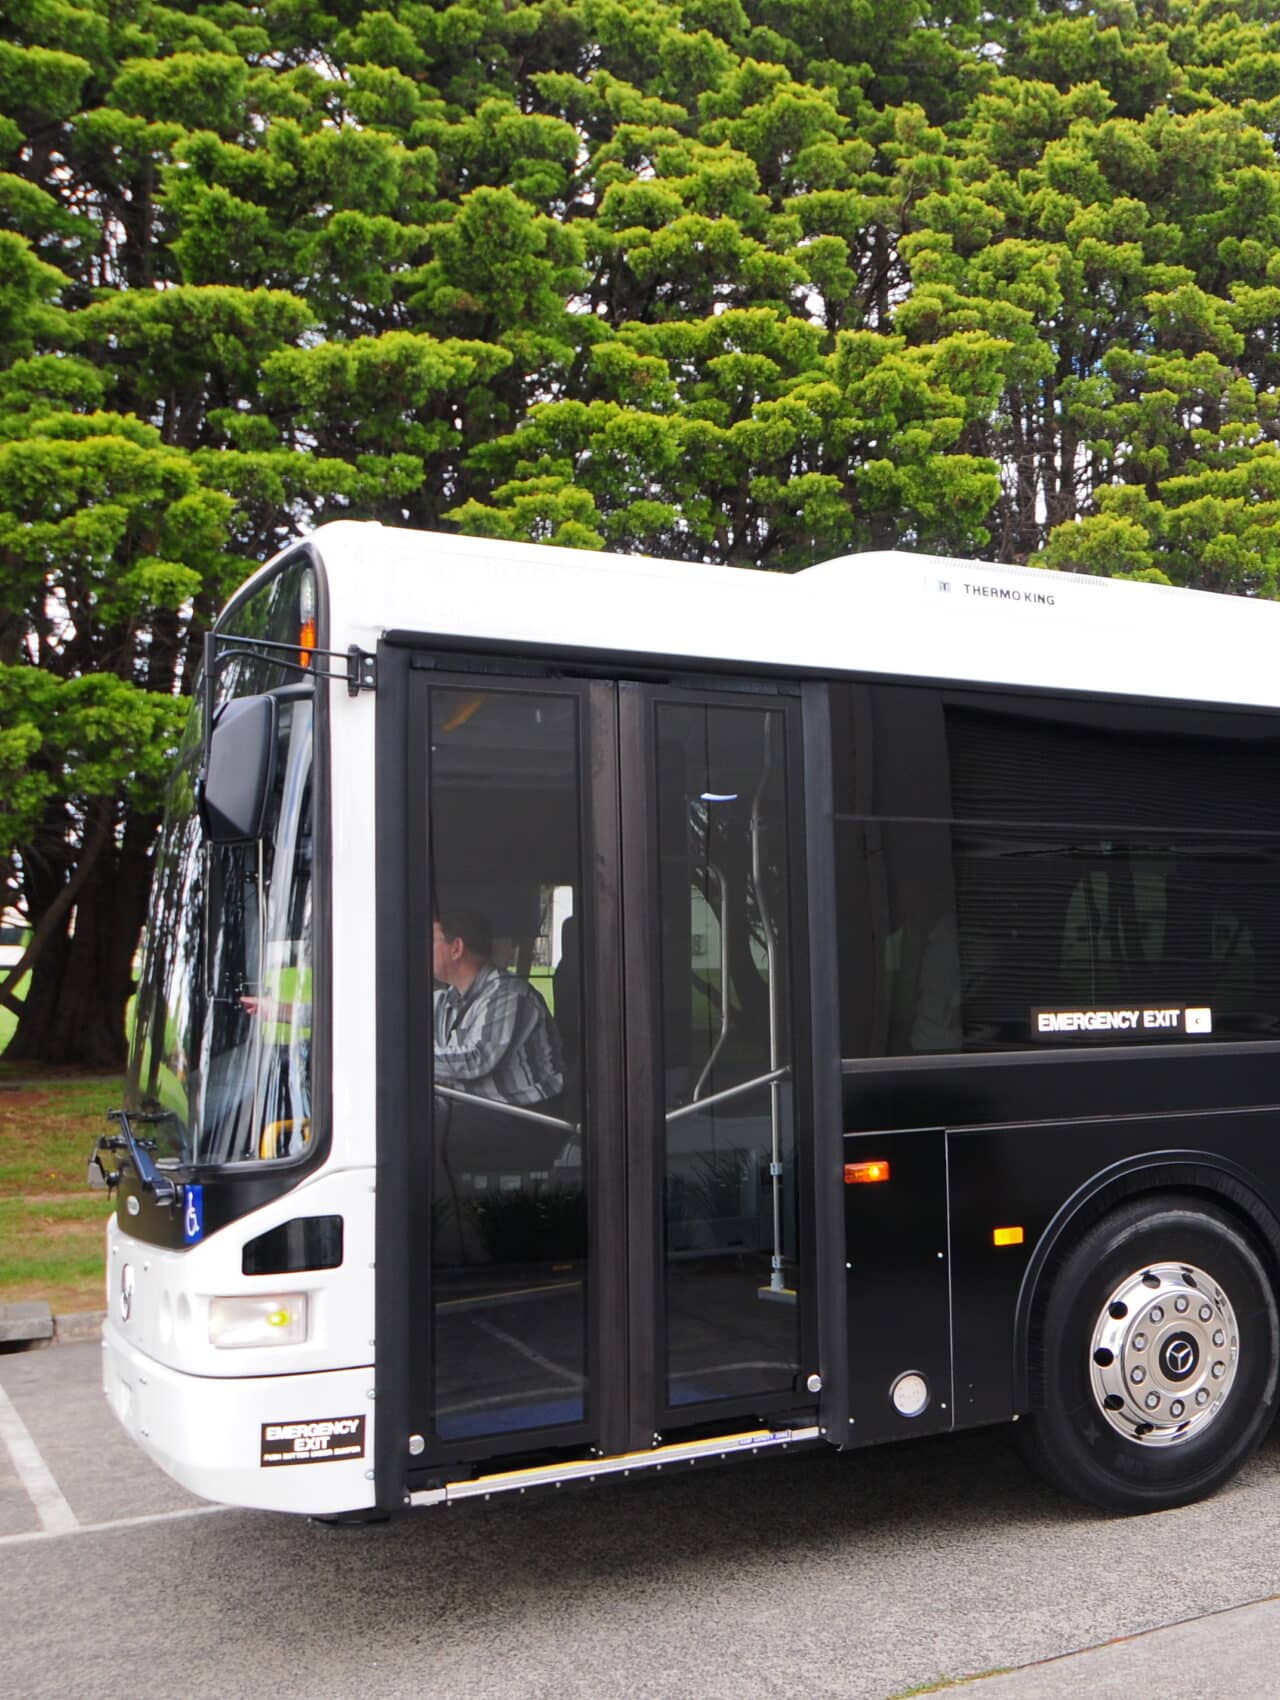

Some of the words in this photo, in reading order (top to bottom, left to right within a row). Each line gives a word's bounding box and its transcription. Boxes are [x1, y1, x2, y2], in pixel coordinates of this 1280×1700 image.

[963, 583, 1021, 601] THERMO
[1024, 592, 1056, 605] KING
[1037, 1011, 1140, 1032] EMERGENCY
[1142, 1009, 1181, 1028] EXIT
[265, 1418, 361, 1441] EMERGENCY
[293, 1435, 331, 1452] EXIT
